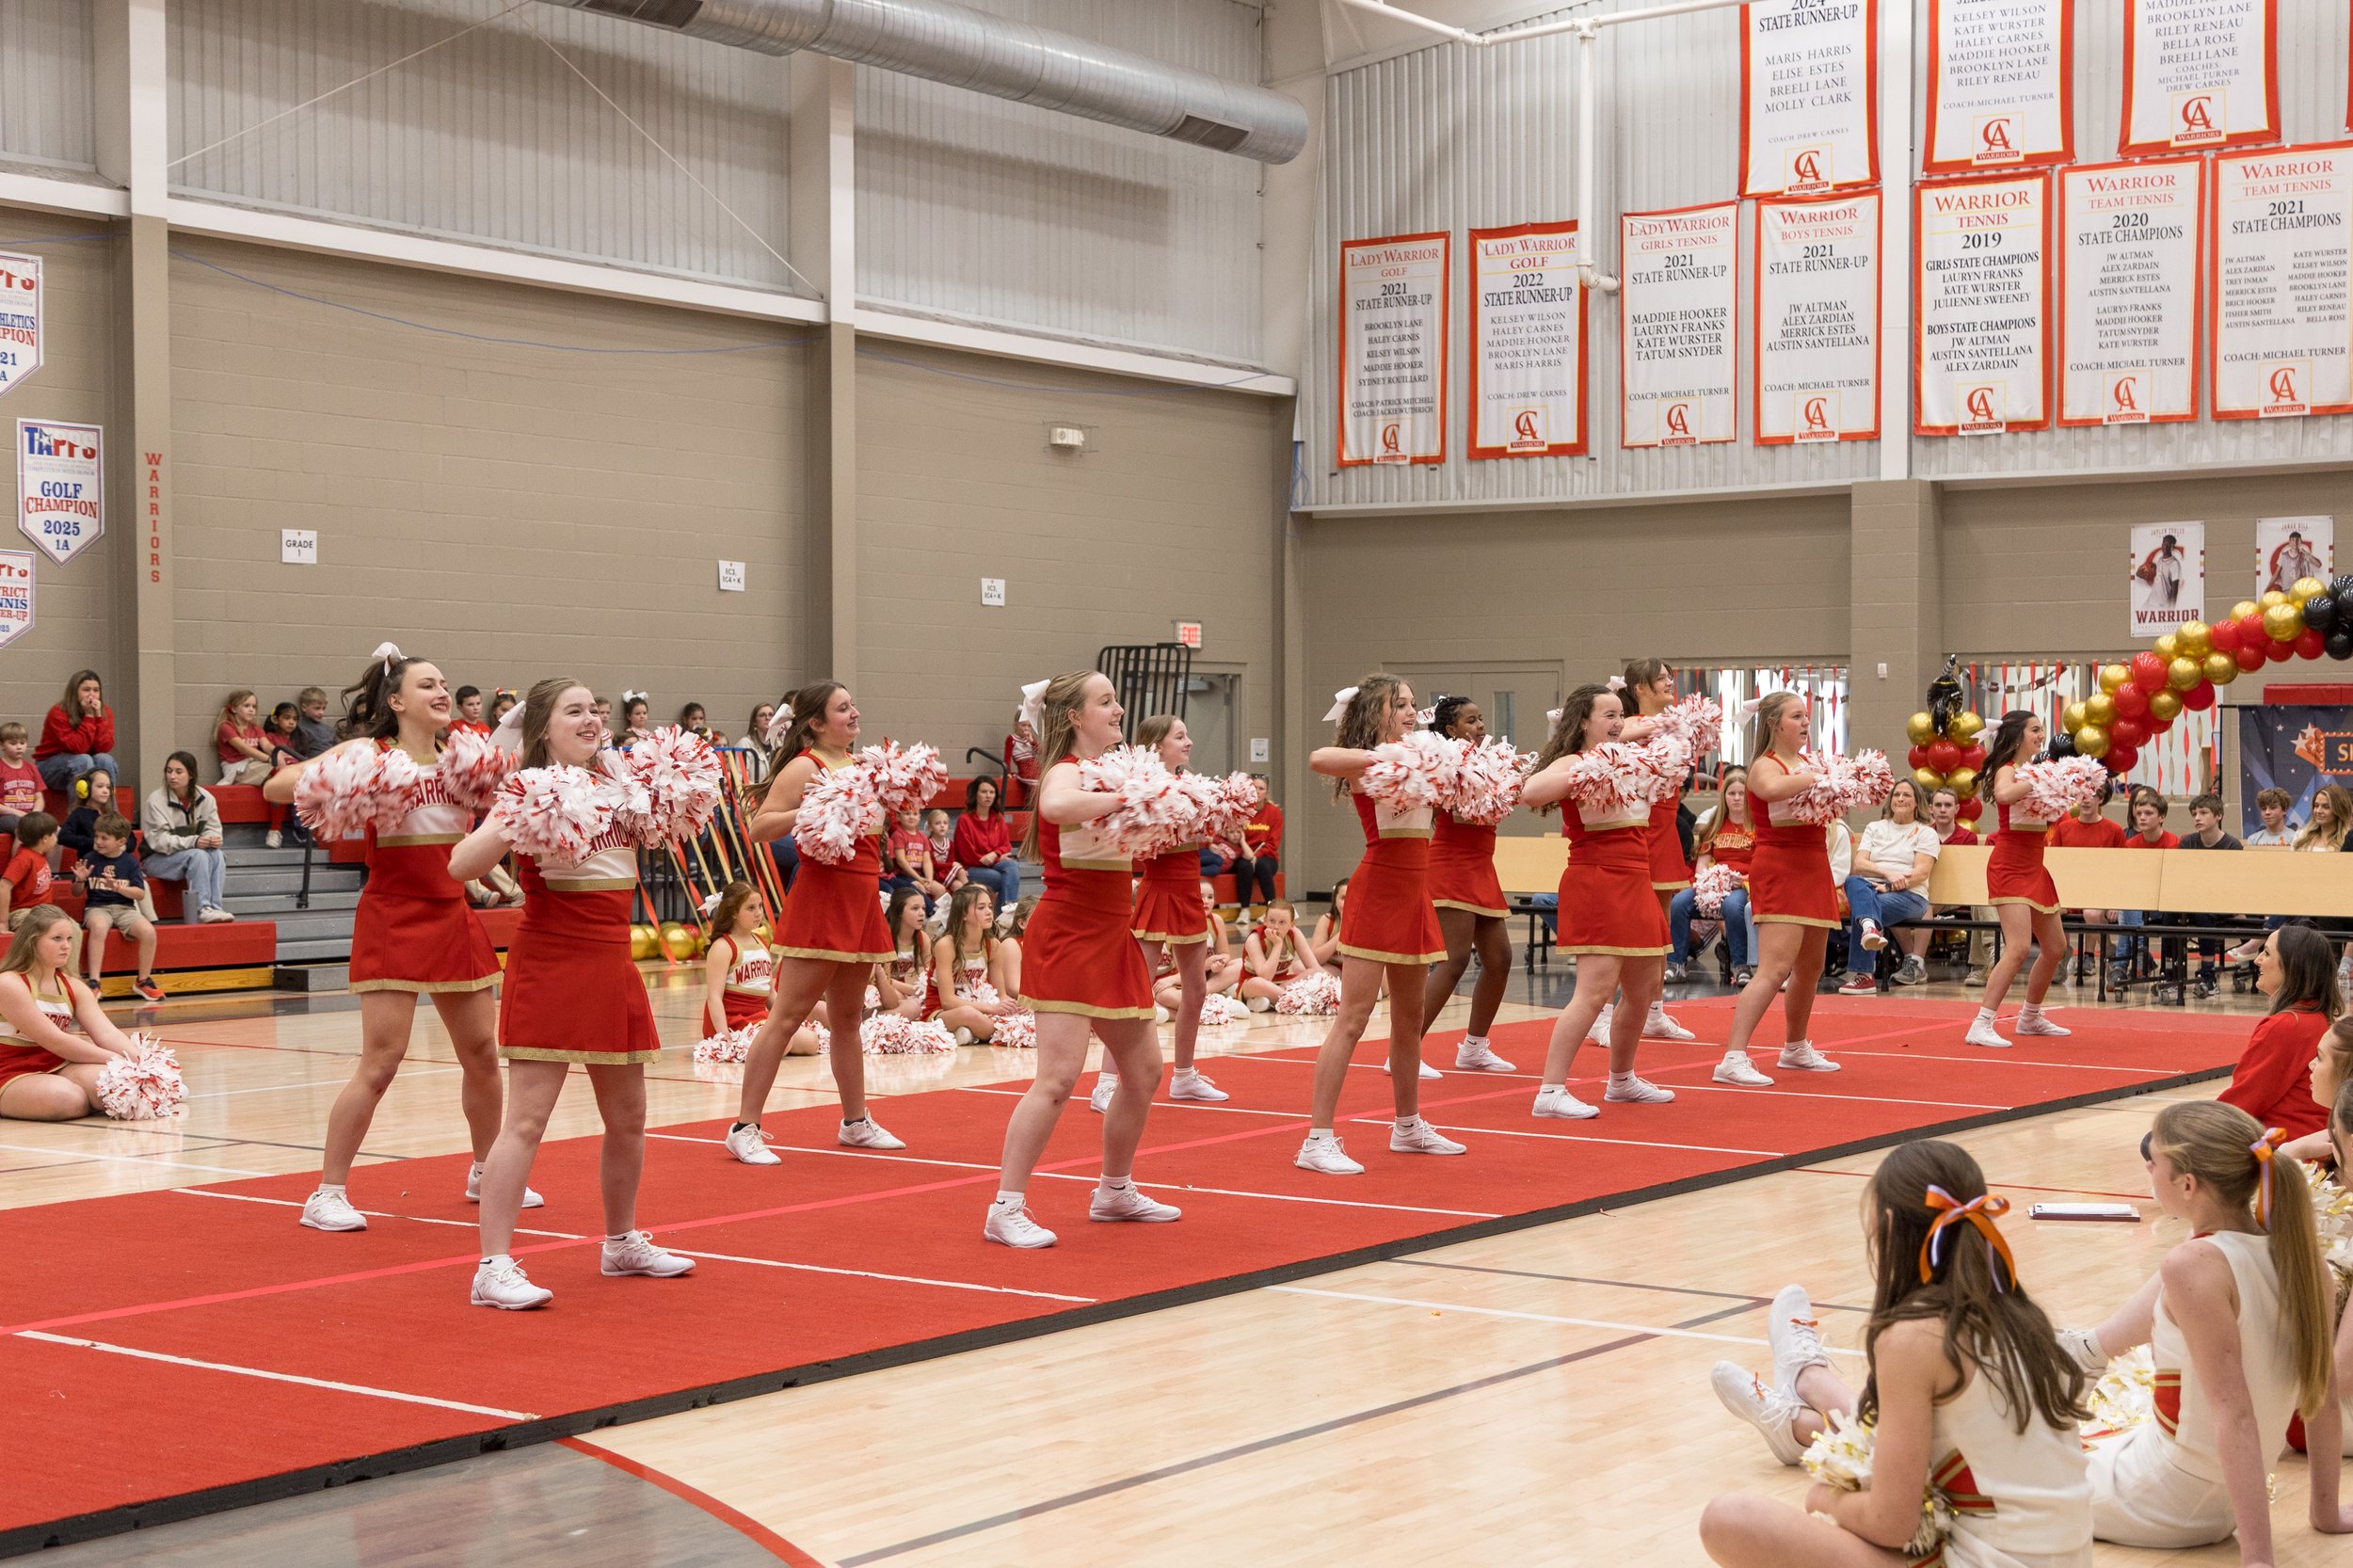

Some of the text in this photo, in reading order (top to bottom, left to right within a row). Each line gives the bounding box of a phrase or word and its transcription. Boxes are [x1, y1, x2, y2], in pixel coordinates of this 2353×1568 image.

[1759, 4, 1858, 32] STATE RUNNER-UP
[1954, 5, 2046, 23] KELSEY WILSON
[2148, 2, 2252, 24] BROOKLYN LANE
[1954, 18, 2045, 36] KATE WURSTER
[2155, 18, 2244, 38] RILEY RENEAU
[1956, 31, 2043, 48] HALEY CARNES
[2163, 33, 2236, 50] BELLA ROSE
[1766, 44, 1851, 66] MARIS HARRIS
[1948, 43, 2050, 62] MADDIE HOOKER
[2160, 46, 2239, 65] BREELI LANE
[1772, 61, 1844, 81] ELISE ESTES
[1950, 56, 2048, 74] BROOKLYN LANE
[1770, 76, 1847, 97] BREELI LANE
[1958, 71, 2041, 87] RILEY RENEAU
[1765, 91, 1851, 113] MOLLY CLARK
[2241, 160, 2333, 179] WARRIOR
[2087, 174, 2176, 193] WARRIOR
[2243, 179, 2331, 197] TEAM TENNIS
[1935, 191, 2030, 212] WARRIOR
[2089, 193, 2174, 209] TEAM TENNIS
[2268, 200, 2304, 216] 2021
[1780, 208, 1858, 224] WARRIOR
[1957, 213, 2009, 228] TENNIS
[2113, 213, 2149, 228] 2020
[2233, 213, 2341, 234] STATE CHAMPIONS
[1629, 216, 1729, 236] LADY WARRIOR
[1782, 226, 1853, 240] BOYS TENNIS
[1641, 235, 1717, 250] GIRLS TENNIS
[1961, 232, 2002, 249] 2019
[2079, 226, 2183, 246] STATE CHAMPIONS
[1484, 237, 1576, 256] LADY WARRIOR
[1803, 245, 1833, 258] 2021
[1351, 248, 1439, 266] LADY WARRIOR
[1510, 256, 1549, 269] GOLF
[1664, 254, 1693, 268] 2021
[1769, 255, 1867, 274] STATE RUNNER-UP
[1926, 251, 2039, 271] GIRLS STATE CHAMPIONS
[1381, 267, 1407, 277] GOLF
[1513, 273, 1544, 288] 2022
[1632, 265, 1726, 284] STATE RUNNER-UP
[1943, 268, 2024, 283] LAURYN FRANKS
[1381, 283, 1407, 296] 2021
[1484, 287, 1572, 307] STATE RUNNER-UP
[1945, 281, 2021, 296] KATE WURSTER
[1356, 294, 1432, 311] STATE RUNNER-UP
[1789, 300, 1847, 314] JW ALTMAN
[1933, 292, 2031, 311] JULIENNE SWEENEY
[1632, 307, 1727, 325] MADDIE HOOKER
[1782, 312, 1854, 327] ALEX ZARDIAN
[1634, 319, 1725, 336] LAURYN FRANKS
[1781, 324, 1856, 339] MERRICK ESTES
[1928, 317, 2036, 335] BOYS STATE CHAMPIONS
[1637, 332, 1722, 348] KATE WURSTER
[1767, 336, 1869, 351] AUSTIN SANTELLANA
[1951, 334, 2010, 348] JW ALTMAN
[1488, 346, 1567, 359] BROOKLYN LANE
[1636, 345, 1722, 360] TATUM SNYDER
[1930, 344, 2032, 360] AUSTIN SANTELLANA
[2224, 346, 2345, 362] COACH: MICHAEL TURNER
[1495, 360, 1561, 370] MARIS HARRIS
[1945, 360, 2019, 372] ALEX ZARDAIN
[2071, 358, 2185, 371] COACH: MICHAEL TURNER
[1629, 387, 1729, 401] COACH: MICHAEL TURNER
[1765, 383, 1796, 392] COACH:
[1798, 381, 1835, 390] MICHAEL
[40, 481, 82, 499] GOLF
[25, 497, 97, 519] CHAMPION
[145, 453, 162, 583] WARRIORS
[44, 520, 80, 536] 2025
[56, 539, 70, 551] 1A
[286, 539, 313, 549] GRADE
[2137, 609, 2199, 624] WARRIOR
